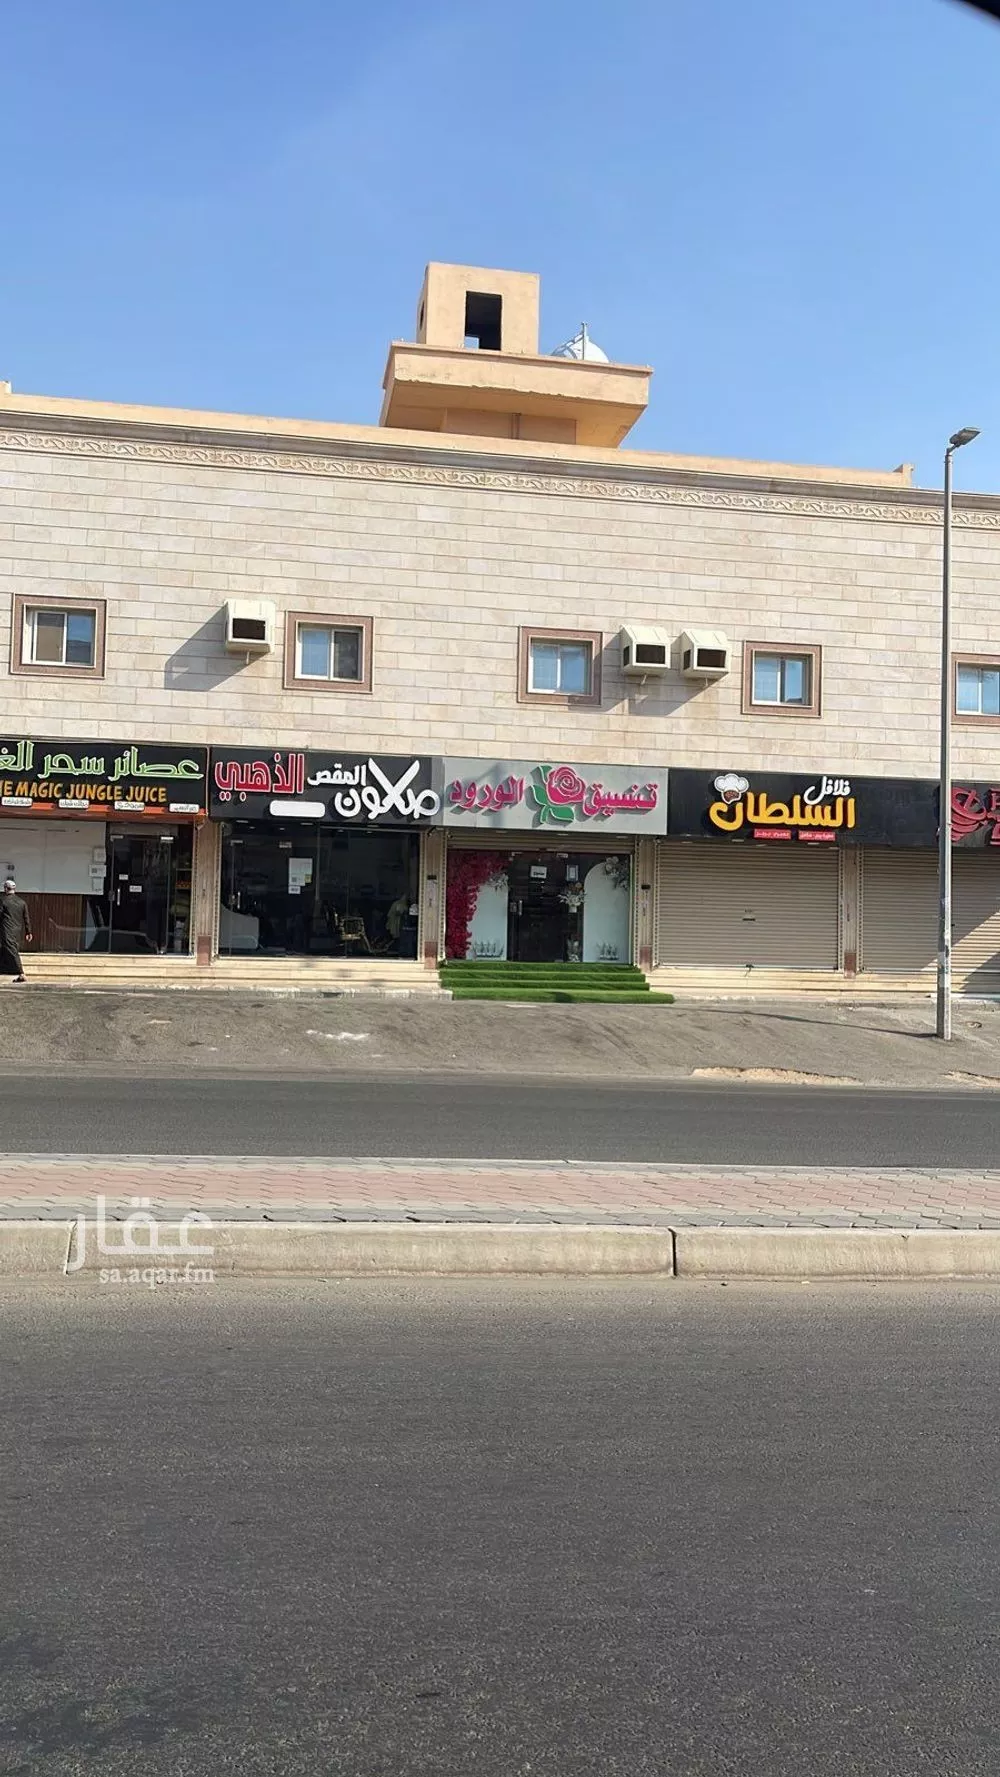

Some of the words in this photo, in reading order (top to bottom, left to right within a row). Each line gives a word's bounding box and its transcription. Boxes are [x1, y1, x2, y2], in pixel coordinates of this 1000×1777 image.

[37, 753, 105, 779] سحر
[107, 746, 204, 782] عصائر
[214, 752, 305, 802] الذهبي
[307, 763, 367, 786] المقص
[15, 781, 63, 798] MAGIC
[66, 783, 122, 801] JUNGLE
[125, 786, 167, 803] JUICE
[449, 776, 524, 811] الورود
[582, 782, 659, 816] تنسيق
[709, 792, 856, 832] السلطان
